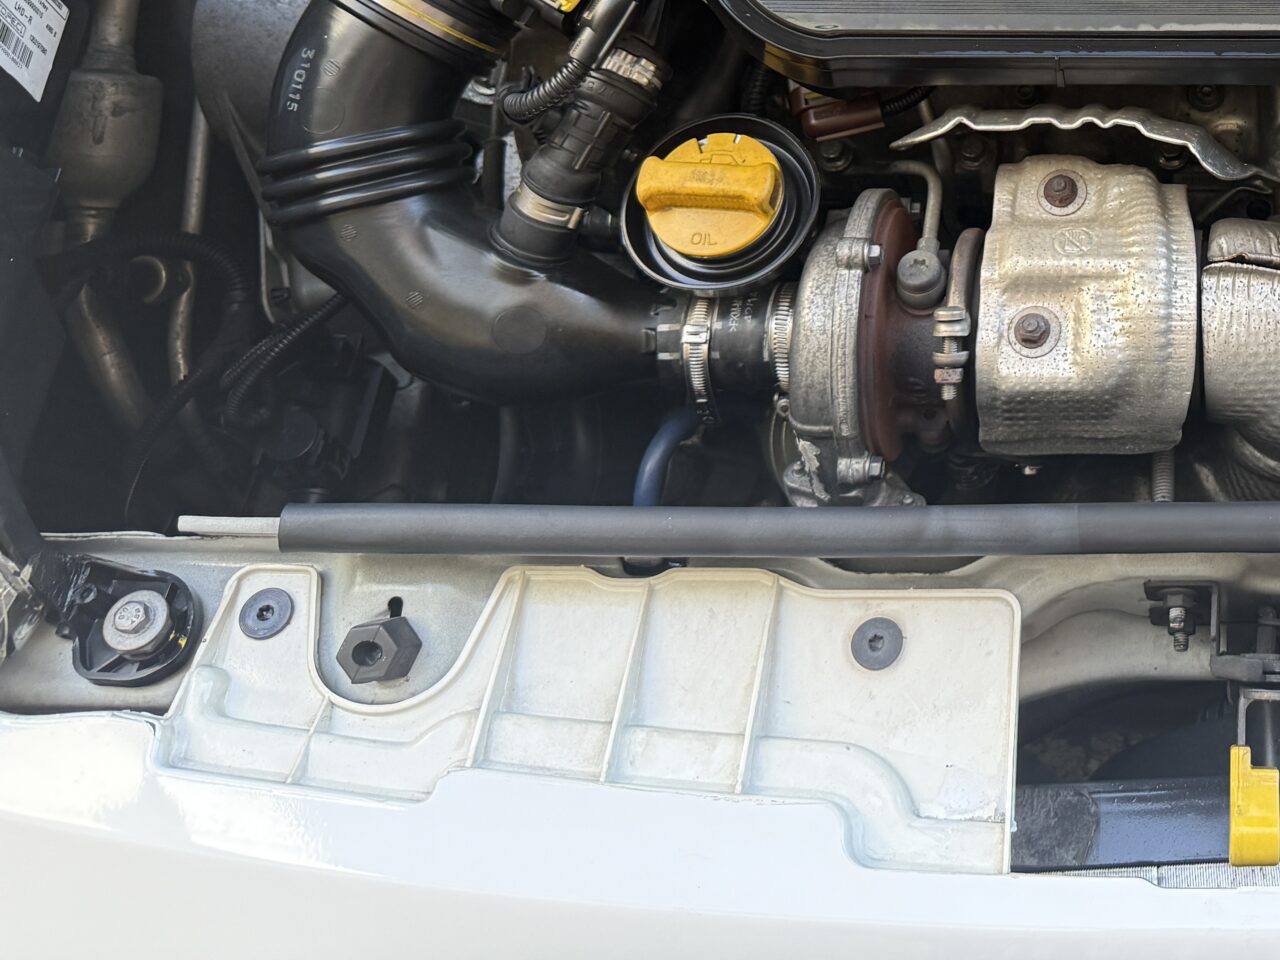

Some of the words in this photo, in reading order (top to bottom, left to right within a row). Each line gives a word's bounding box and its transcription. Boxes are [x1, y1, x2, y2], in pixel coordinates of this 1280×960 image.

[14, 2, 33, 25] LHD-R
[285, 46, 315, 111] 310115
[690, 231, 718, 245] OIL
